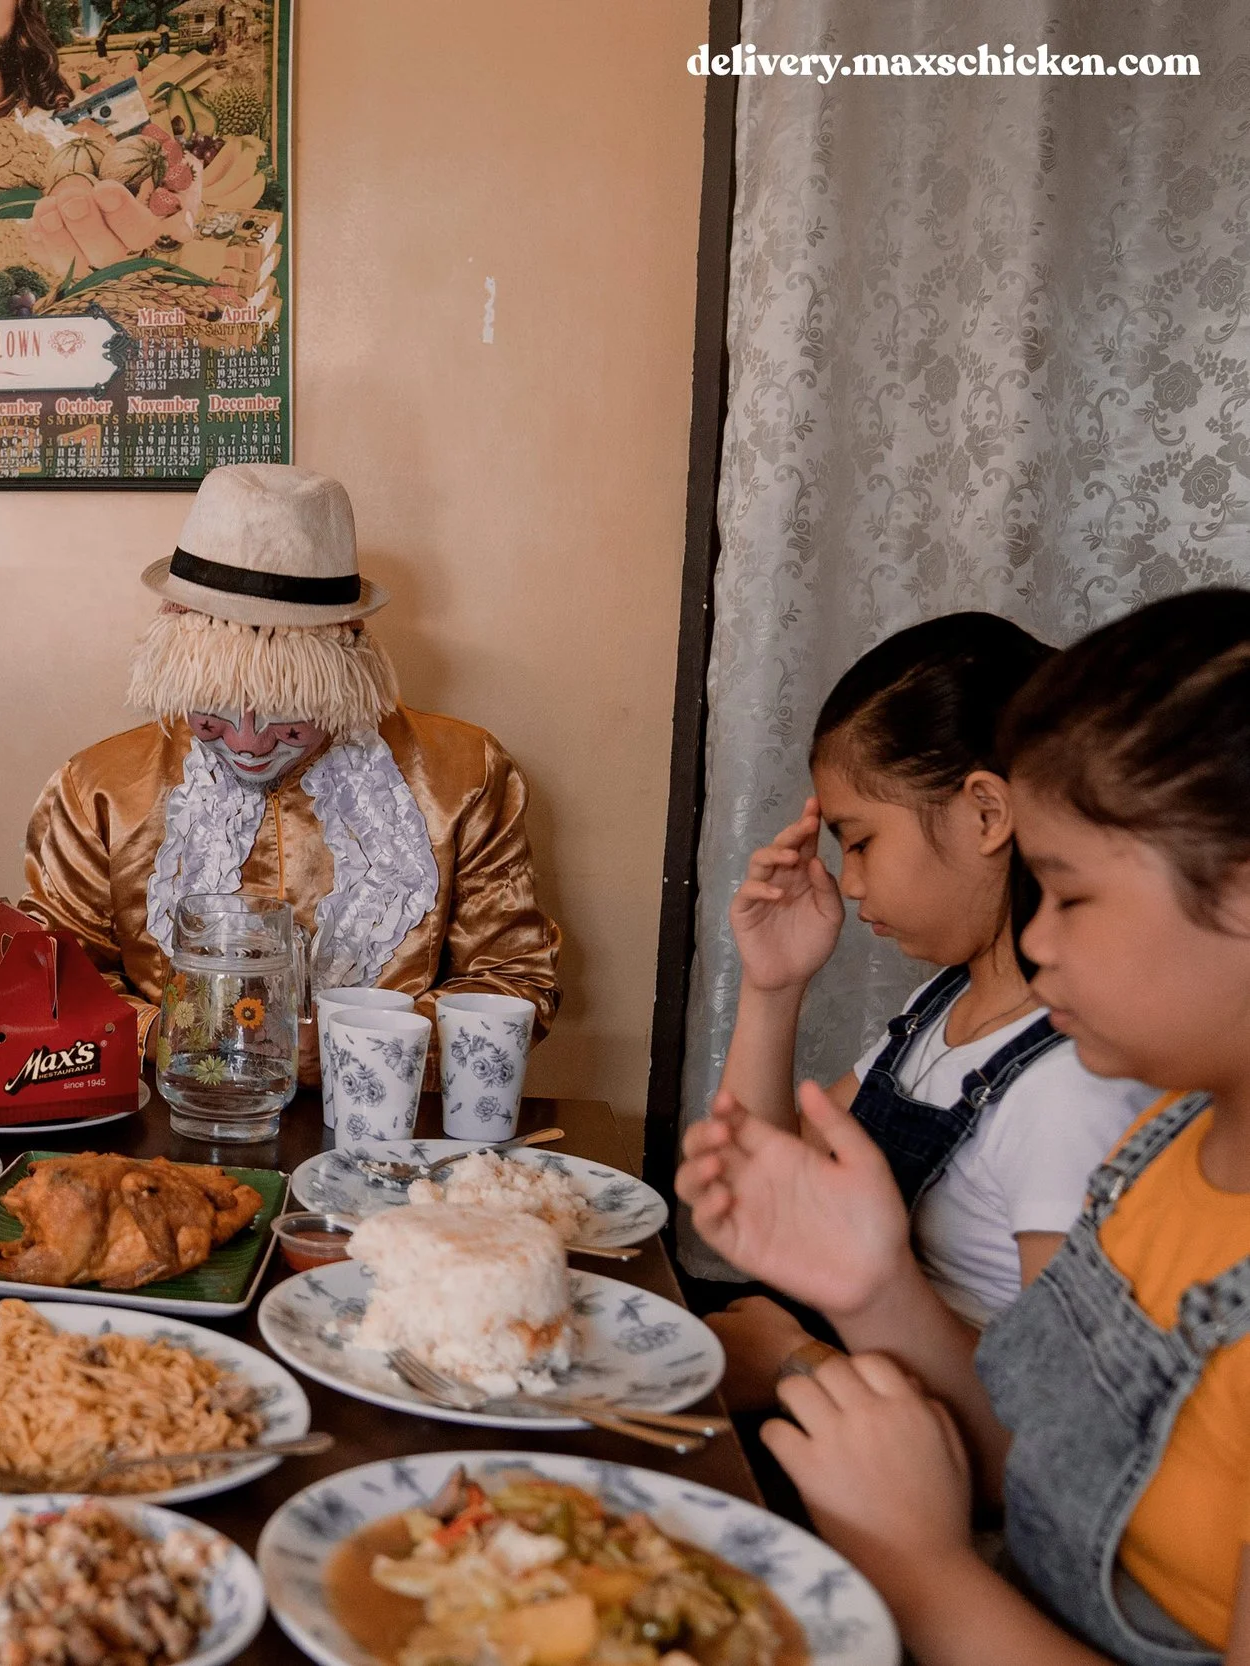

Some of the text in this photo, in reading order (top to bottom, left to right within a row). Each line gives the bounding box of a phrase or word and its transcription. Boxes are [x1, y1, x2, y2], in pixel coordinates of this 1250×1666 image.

[138, 308, 185, 325] March
[222, 306, 258, 323] April
[55, 398, 112, 414] October
[127, 396, 199, 412] November
[208, 394, 281, 411] December
[47, 414, 119, 425] S M T W T F S
[126, 413, 199, 424] S M T W T F S
[207, 411, 280, 423] S M T W T F S
[5, 1041, 95, 1091] Max's
[39, 1063, 95, 1079] RESTAURANT
[63, 1078, 106, 1090] since 1945
